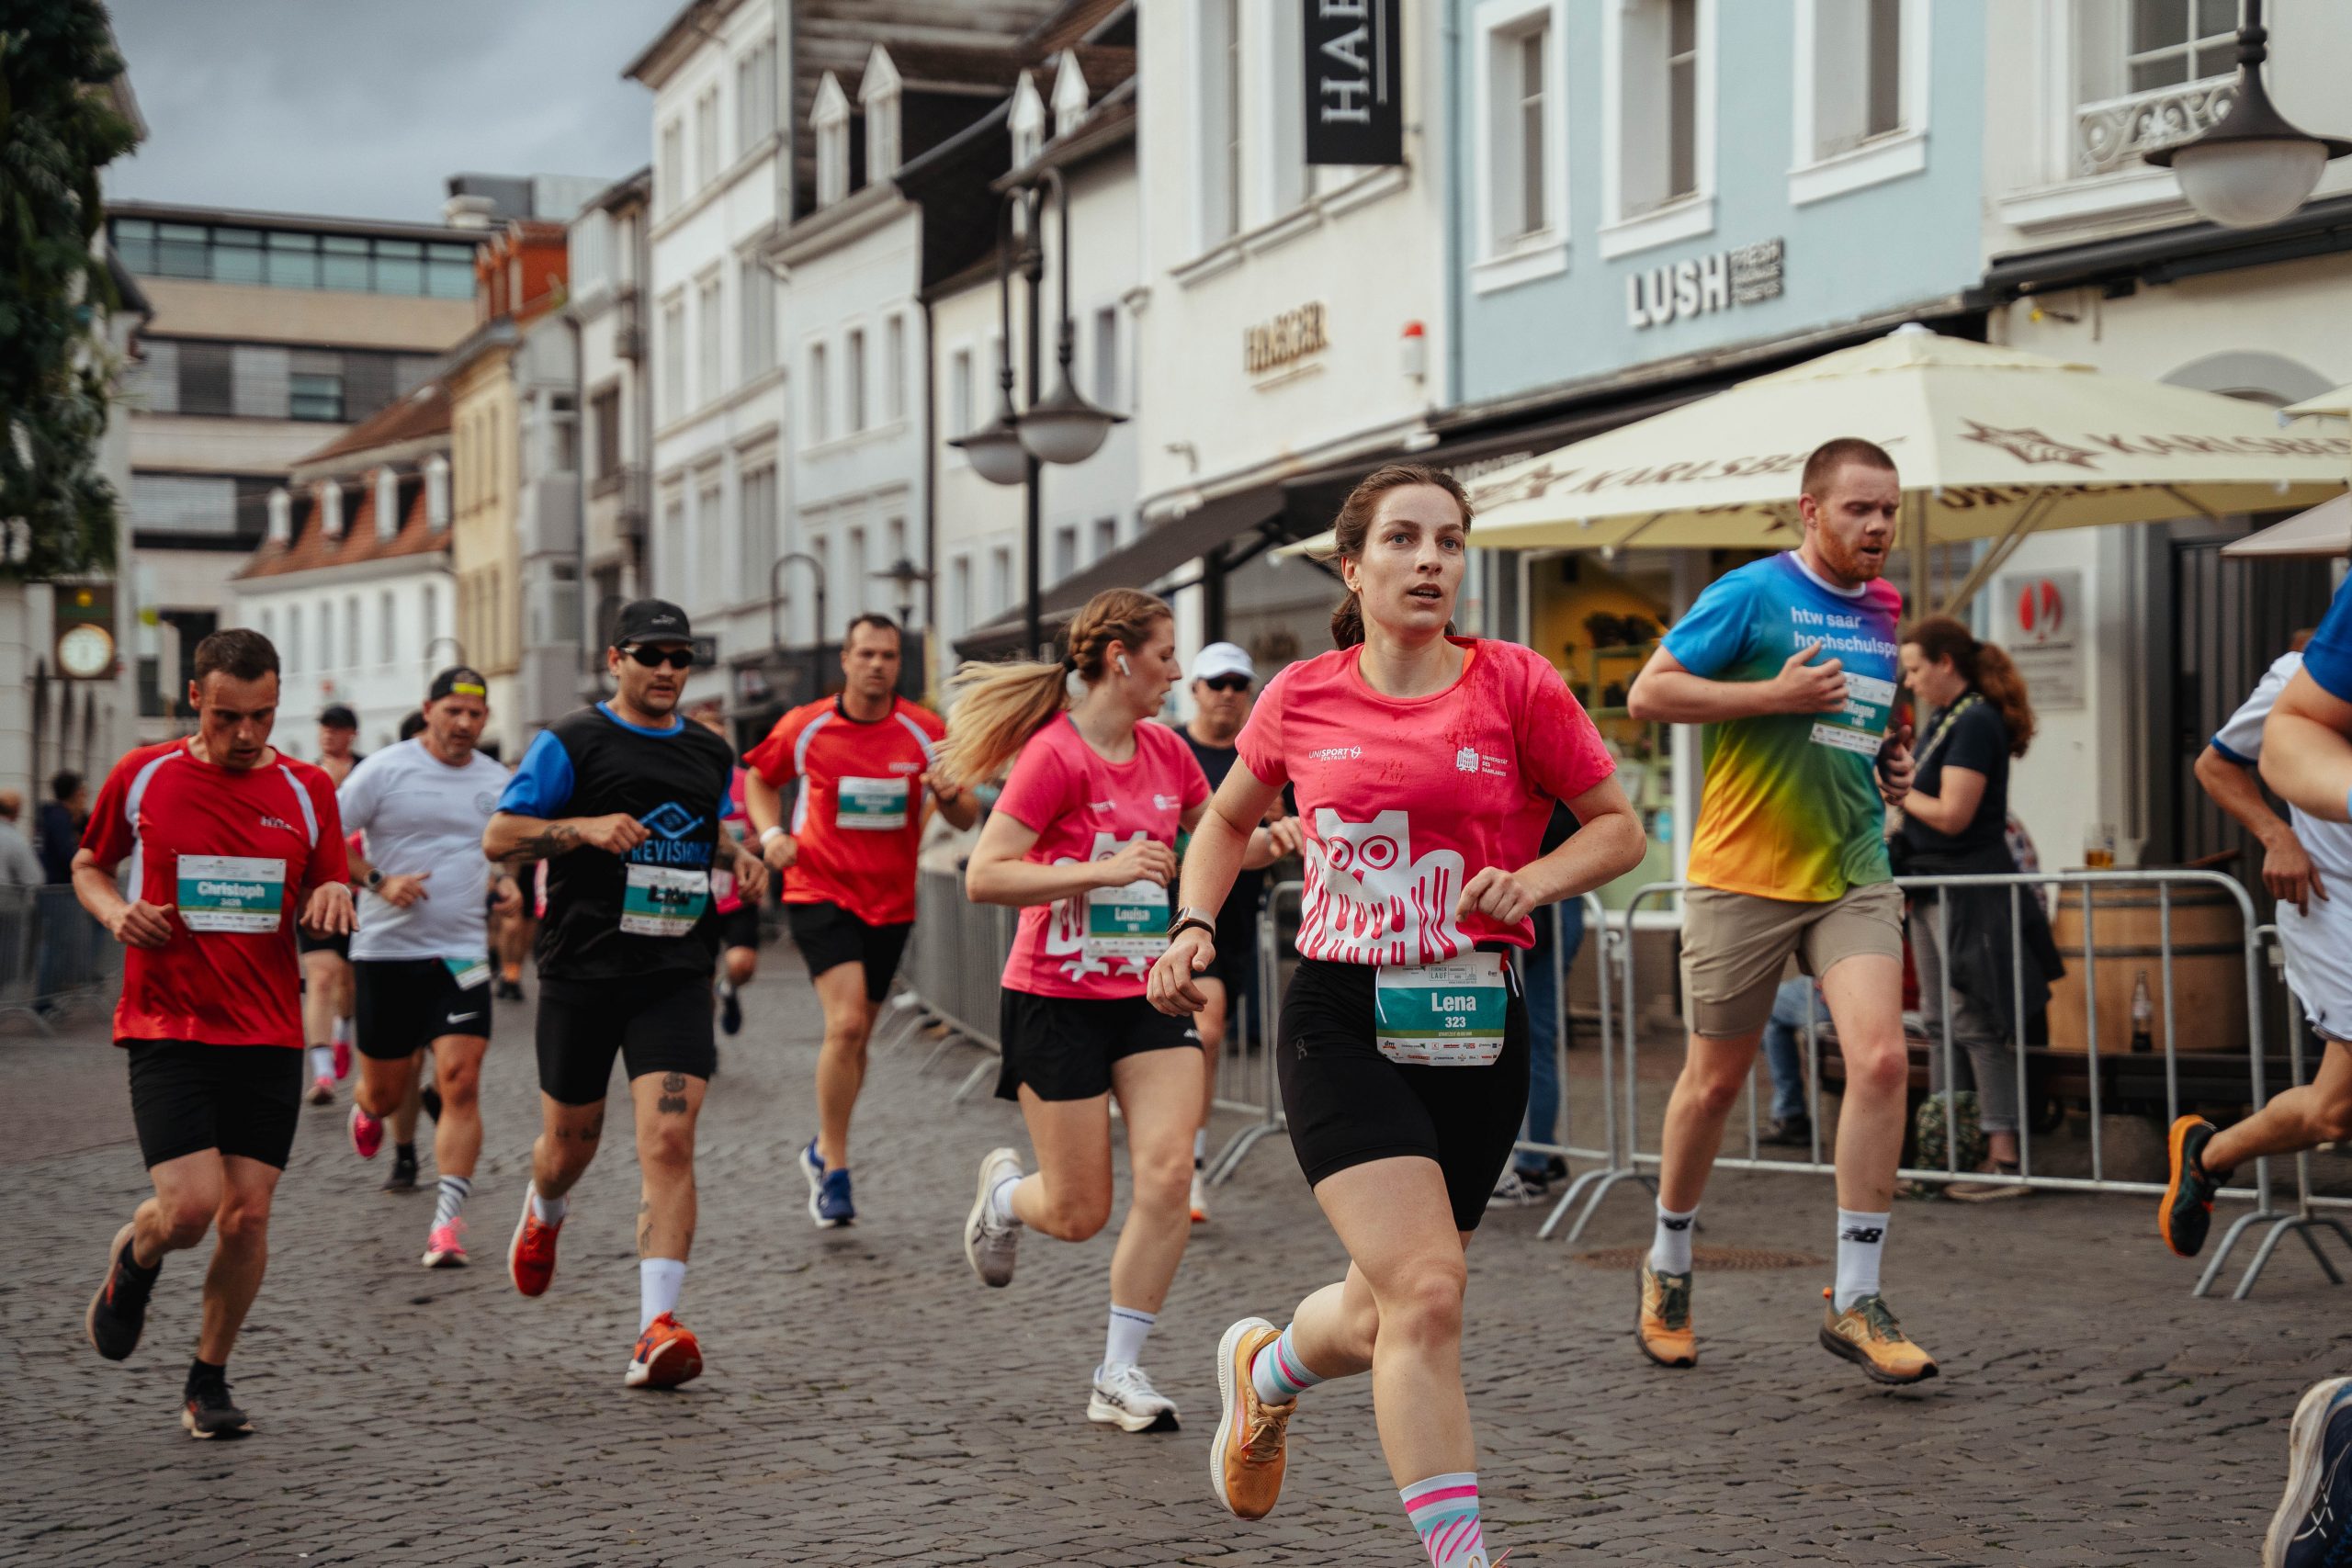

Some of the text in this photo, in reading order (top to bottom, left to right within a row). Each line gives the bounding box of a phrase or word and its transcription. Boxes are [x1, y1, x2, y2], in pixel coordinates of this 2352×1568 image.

[1627, 251, 1731, 329] LUSH
[1791, 606, 1861, 629] htw saar
[1308, 747, 1350, 760] UNISPORT
[620, 839, 712, 864] REVISIONZ
[198, 881, 266, 900] Christoph
[1430, 992, 1477, 1012] Lena
[1444, 1016, 1466, 1028] 323
